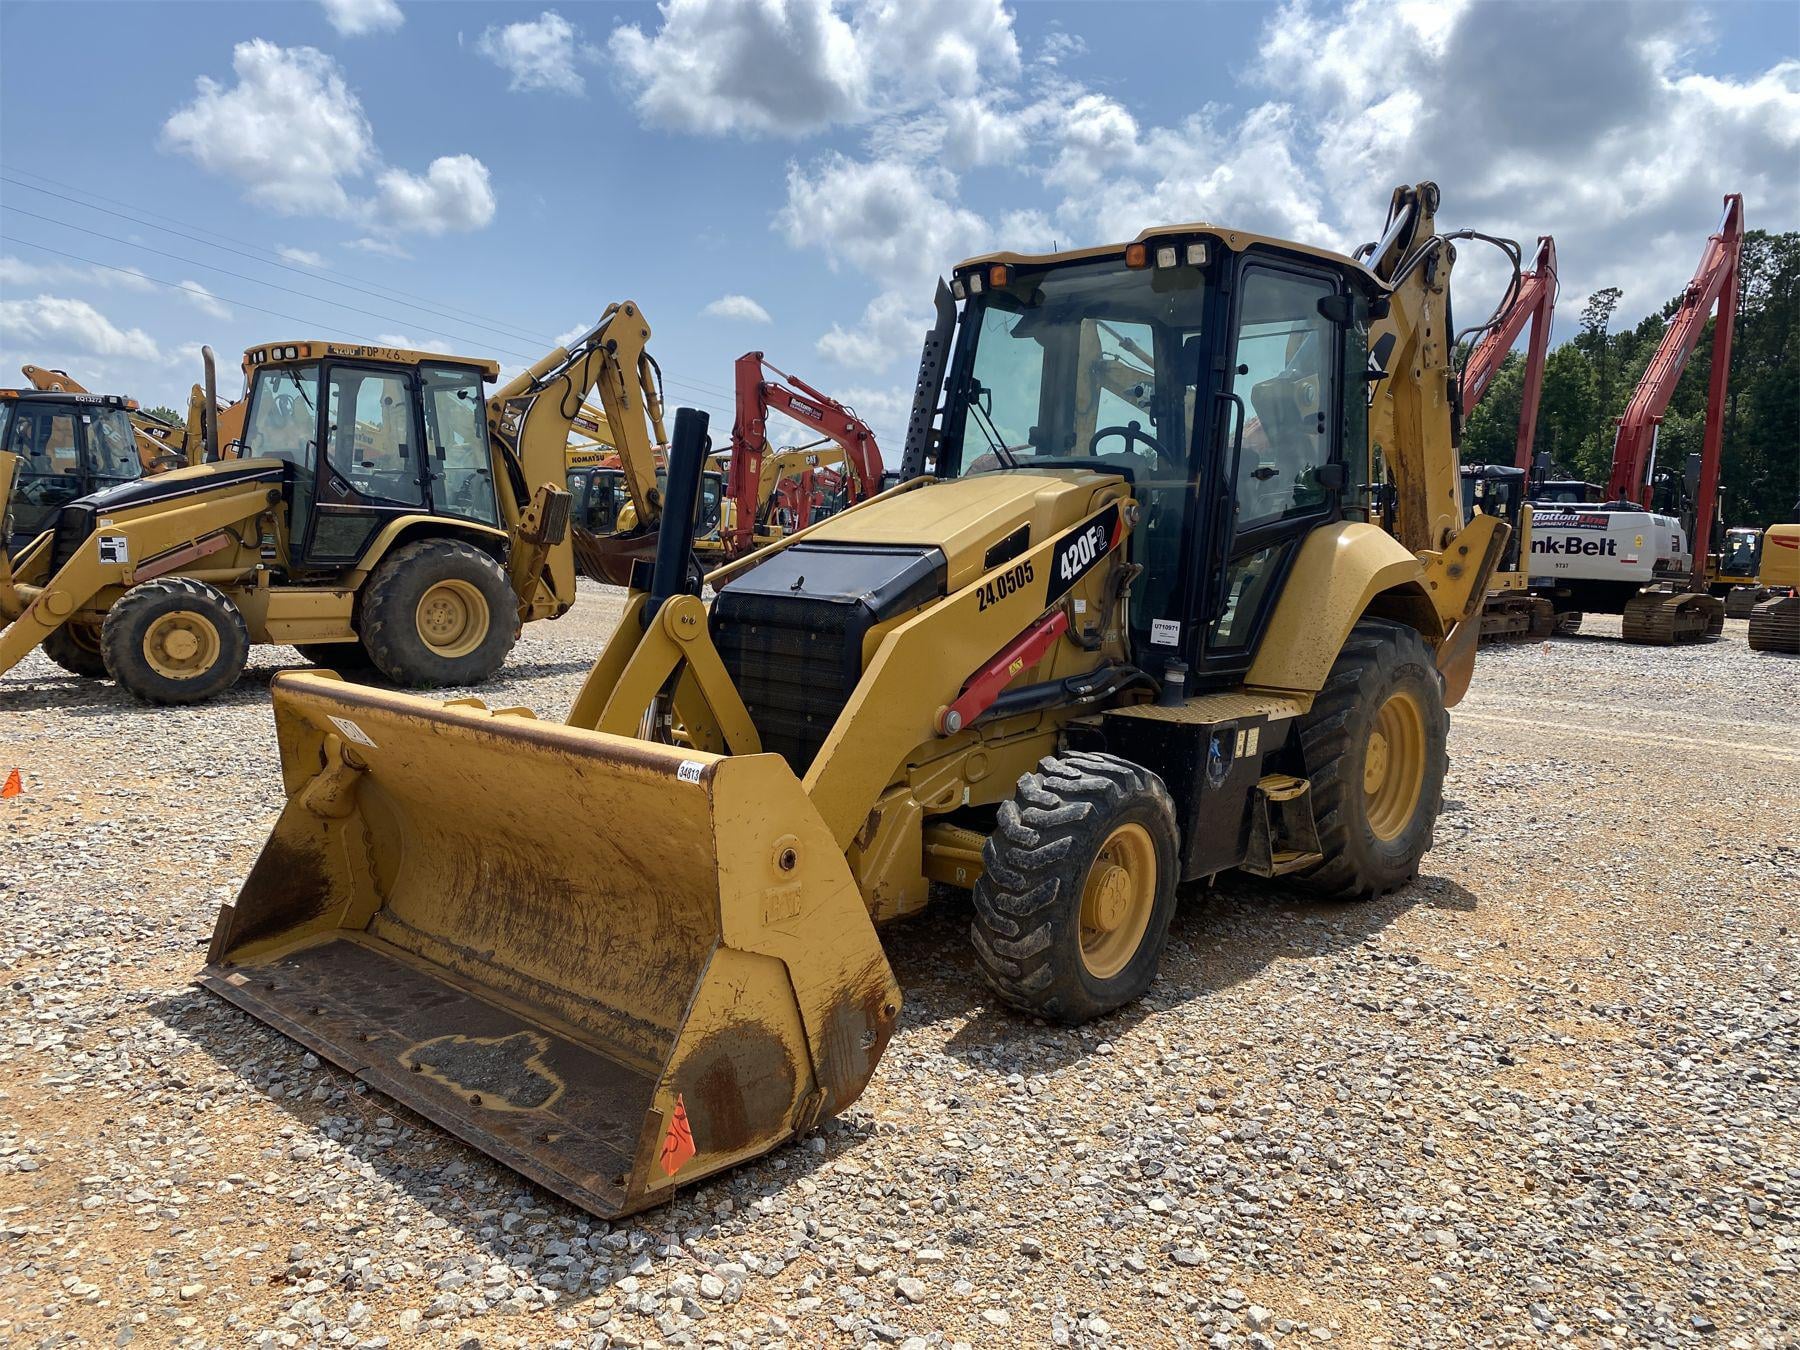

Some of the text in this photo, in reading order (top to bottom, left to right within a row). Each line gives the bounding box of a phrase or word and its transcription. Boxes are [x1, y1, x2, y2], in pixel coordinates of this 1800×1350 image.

[152, 428, 165, 438] CAT
[571, 454, 605, 464] KOMATSU
[805, 455, 817, 464] CAT
[1532, 513, 1580, 521] Bottom
[1531, 536, 1617, 556] nk-Belt
[1060, 525, 1107, 581] 420F2
[976, 560, 1034, 612] 24.0505
[1154, 623, 1178, 631] U710971
[680, 766, 700, 781] 34813
